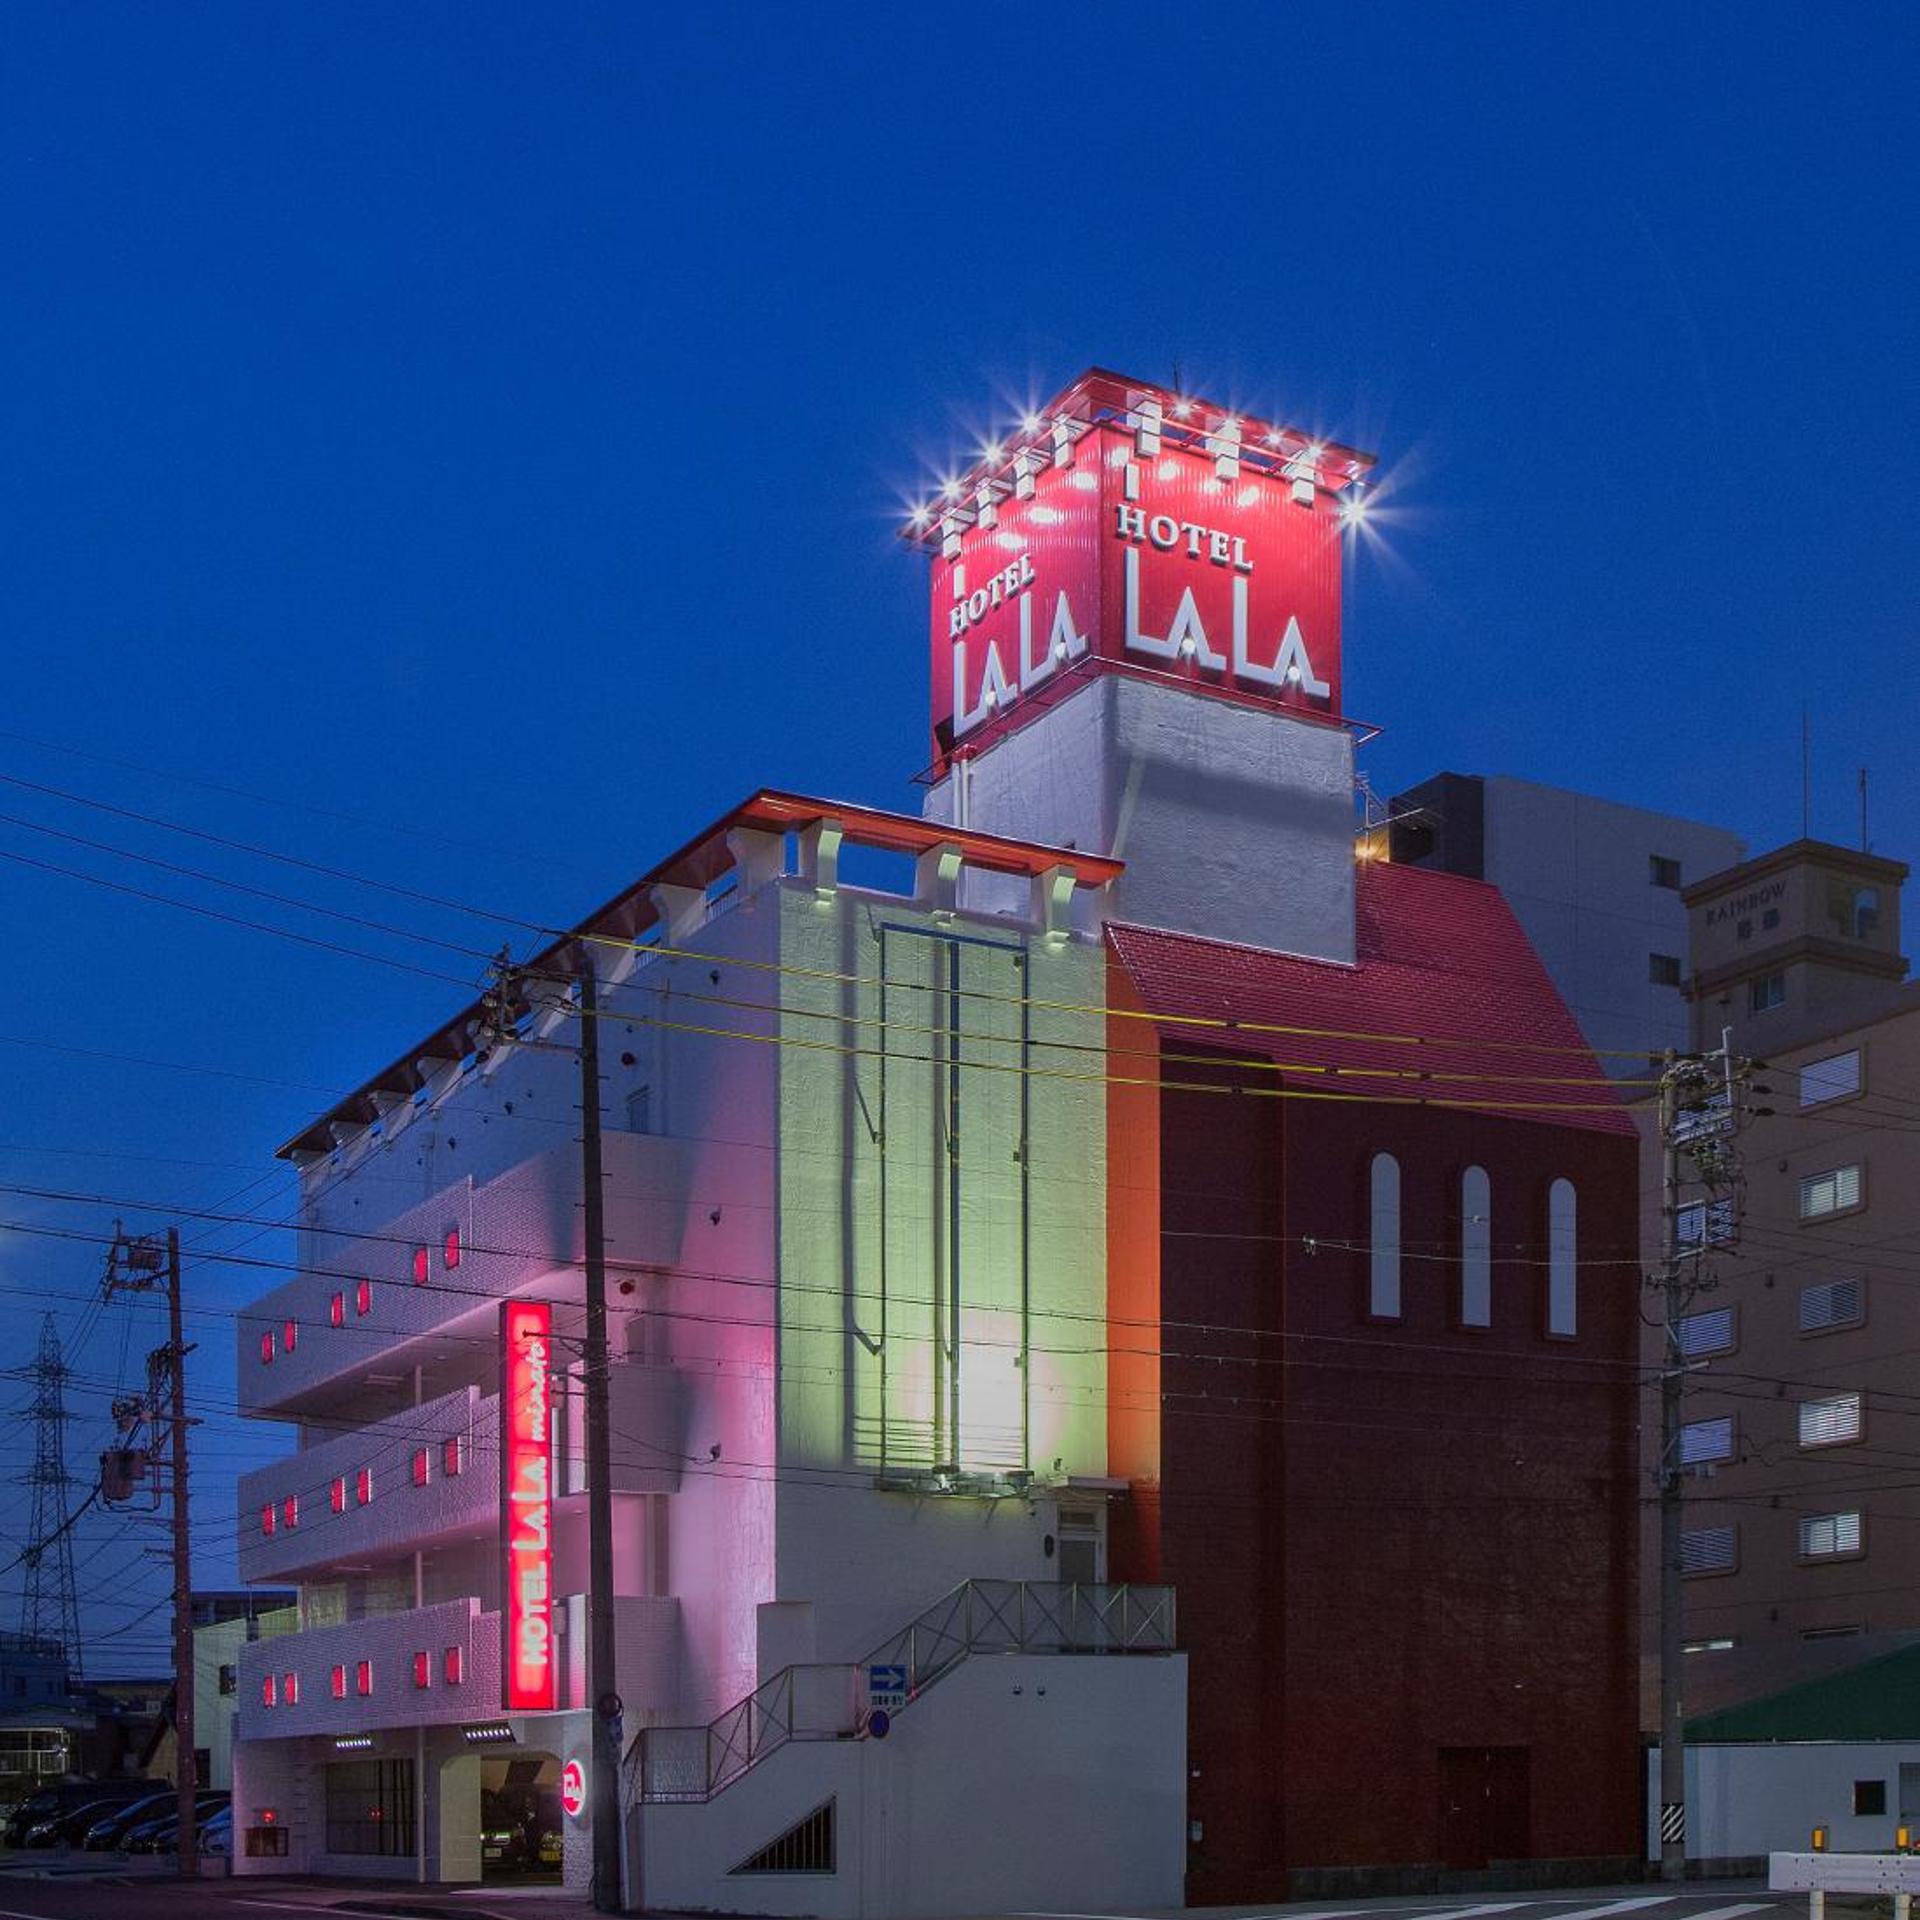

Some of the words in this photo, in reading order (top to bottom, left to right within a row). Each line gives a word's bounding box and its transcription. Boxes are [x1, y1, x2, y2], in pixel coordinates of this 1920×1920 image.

[1117, 504, 1254, 571] HOTEL
[950, 553, 1035, 638] HOTEL
[1706, 880, 1787, 927] RAINBOW
[521, 1561, 548, 1665] HOTEL
